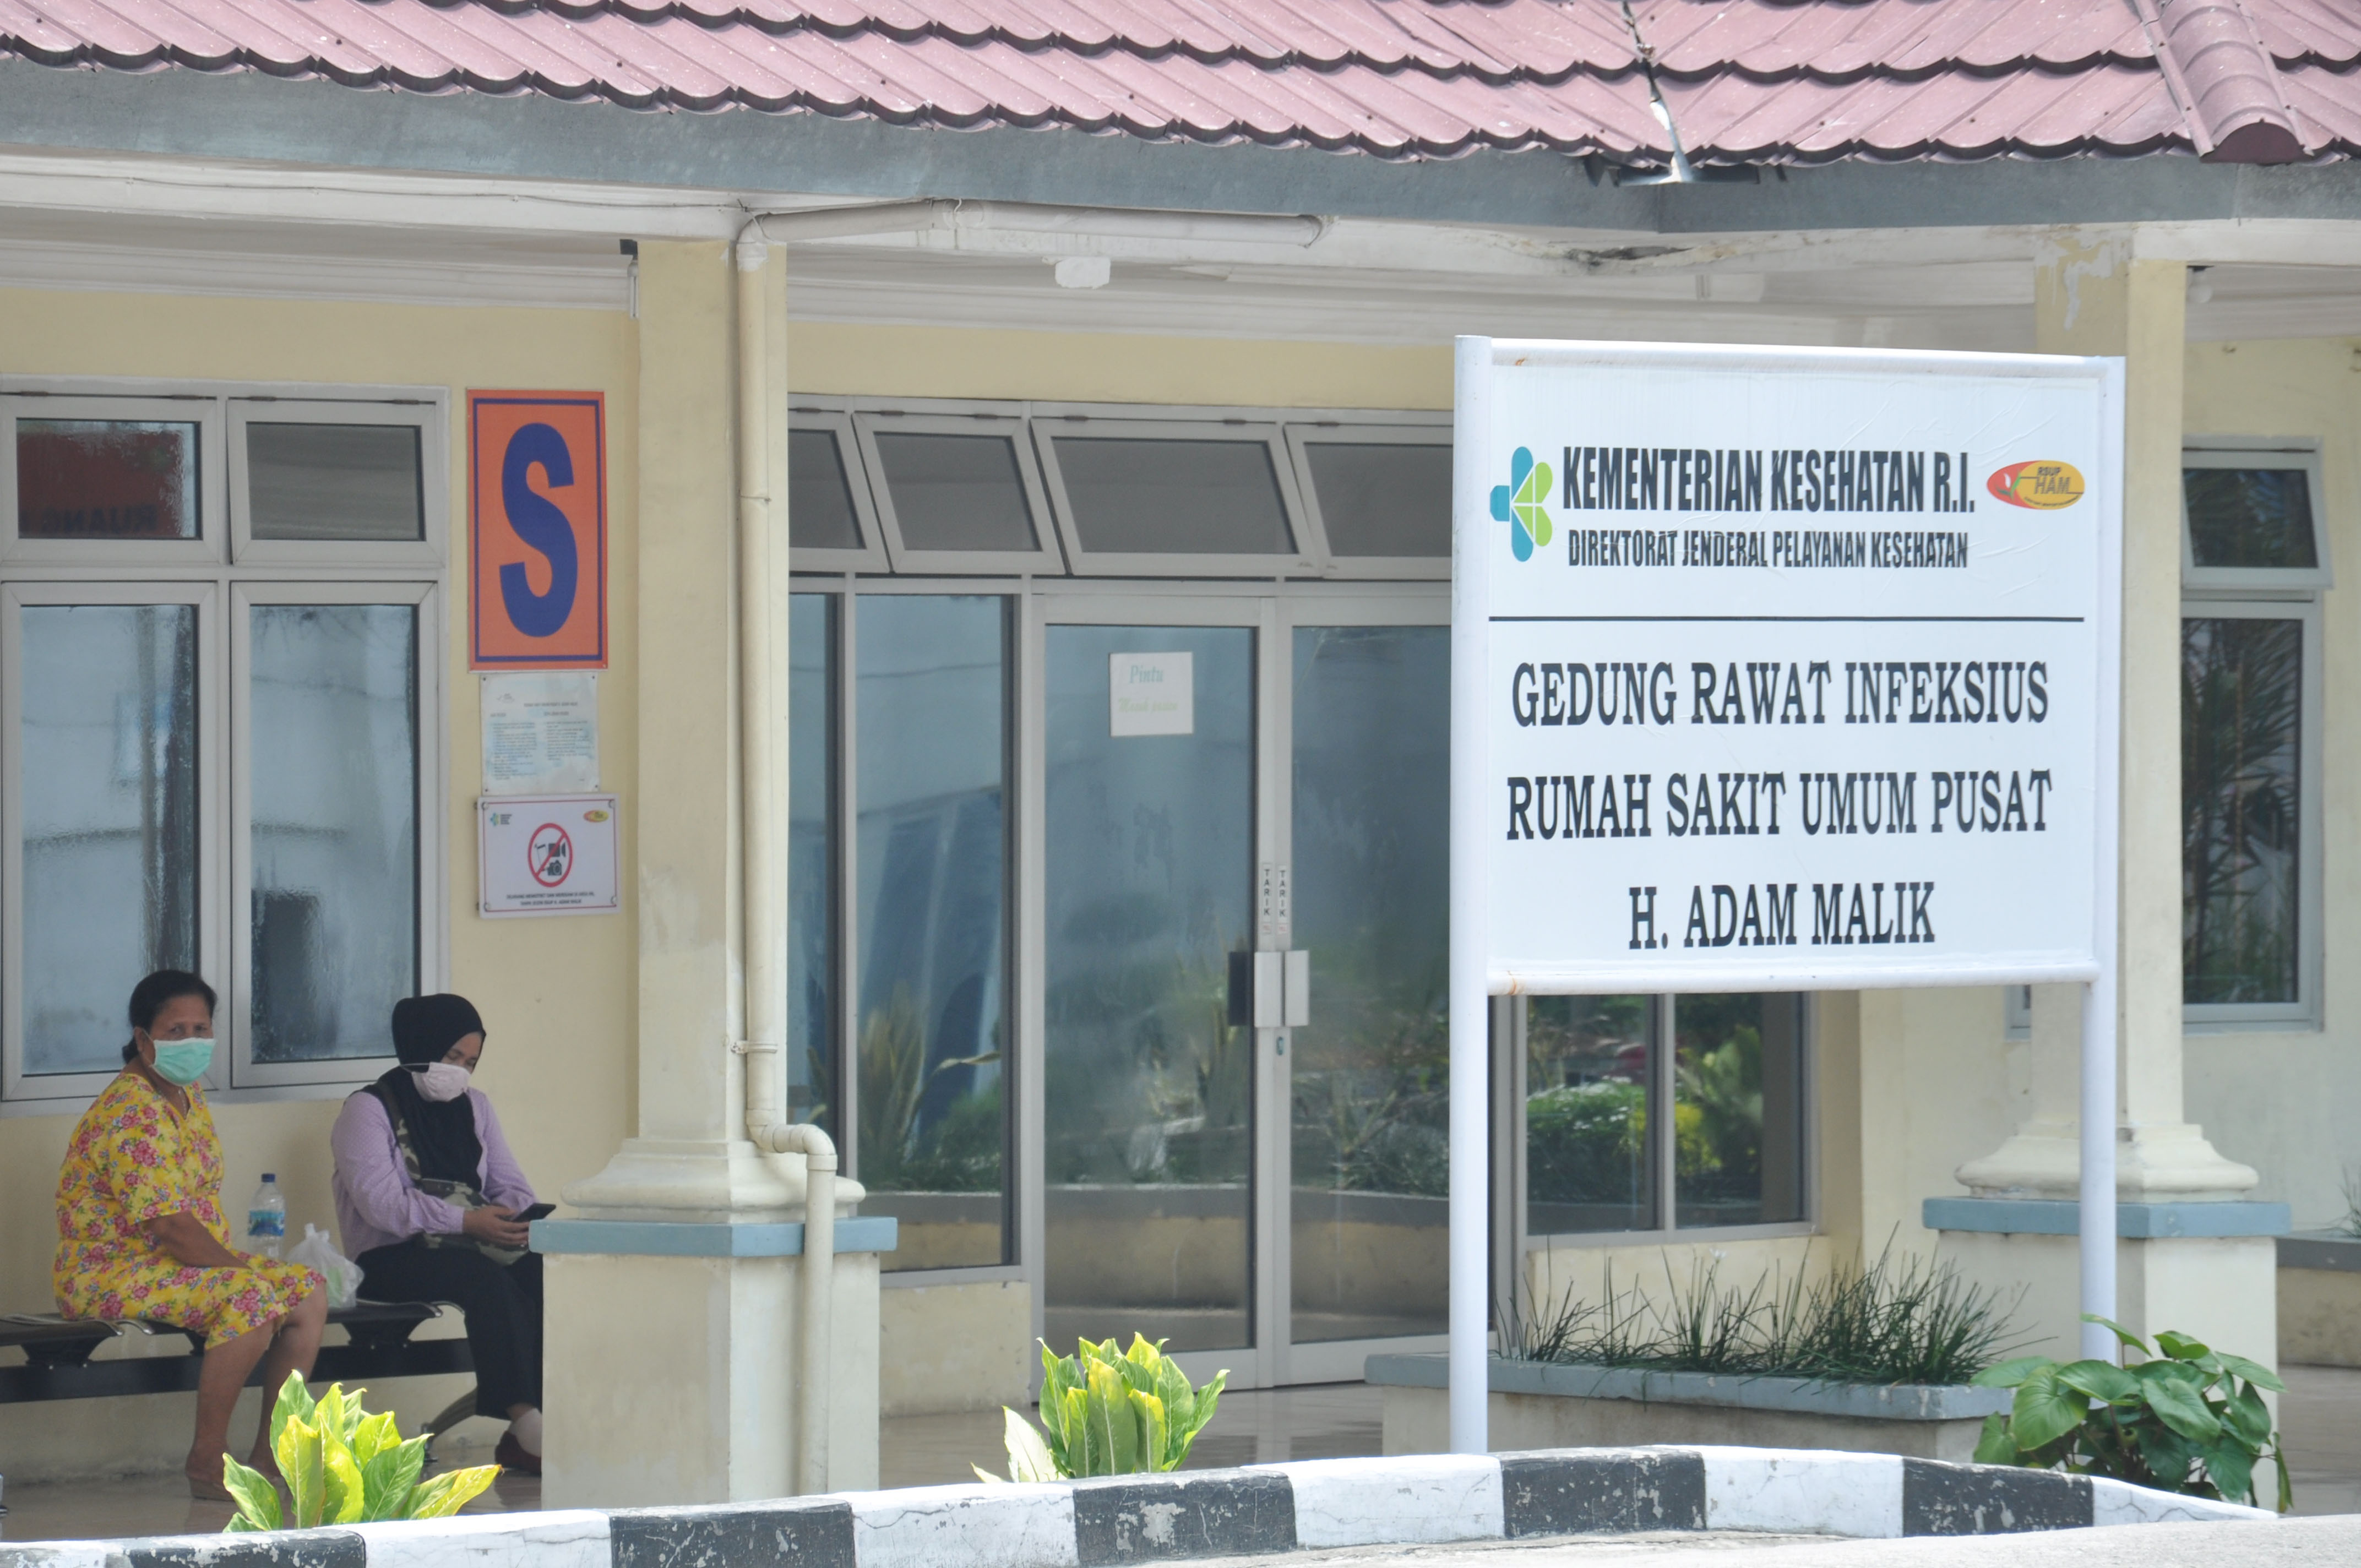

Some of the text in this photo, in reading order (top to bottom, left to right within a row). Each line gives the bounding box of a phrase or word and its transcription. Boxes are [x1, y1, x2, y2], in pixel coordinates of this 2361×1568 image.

[1563, 447, 1975, 513] KEMENTERIAN KESEHATAN R.I.
[2034, 477, 2071, 494] HAM
[499, 422, 578, 638] S
[1569, 529, 1968, 568] DIREKTORAT JENDERAL PELAYANAN KESEHATAN
[1129, 665, 1164, 683] Pintu
[1513, 661, 2048, 727] GEDUNG RAWAT INFEKSIUS
[1507, 769, 2053, 840] RUMAH SAKIT UMUM PUSAT
[1629, 881, 1935, 950] H. ADAM MALIK
